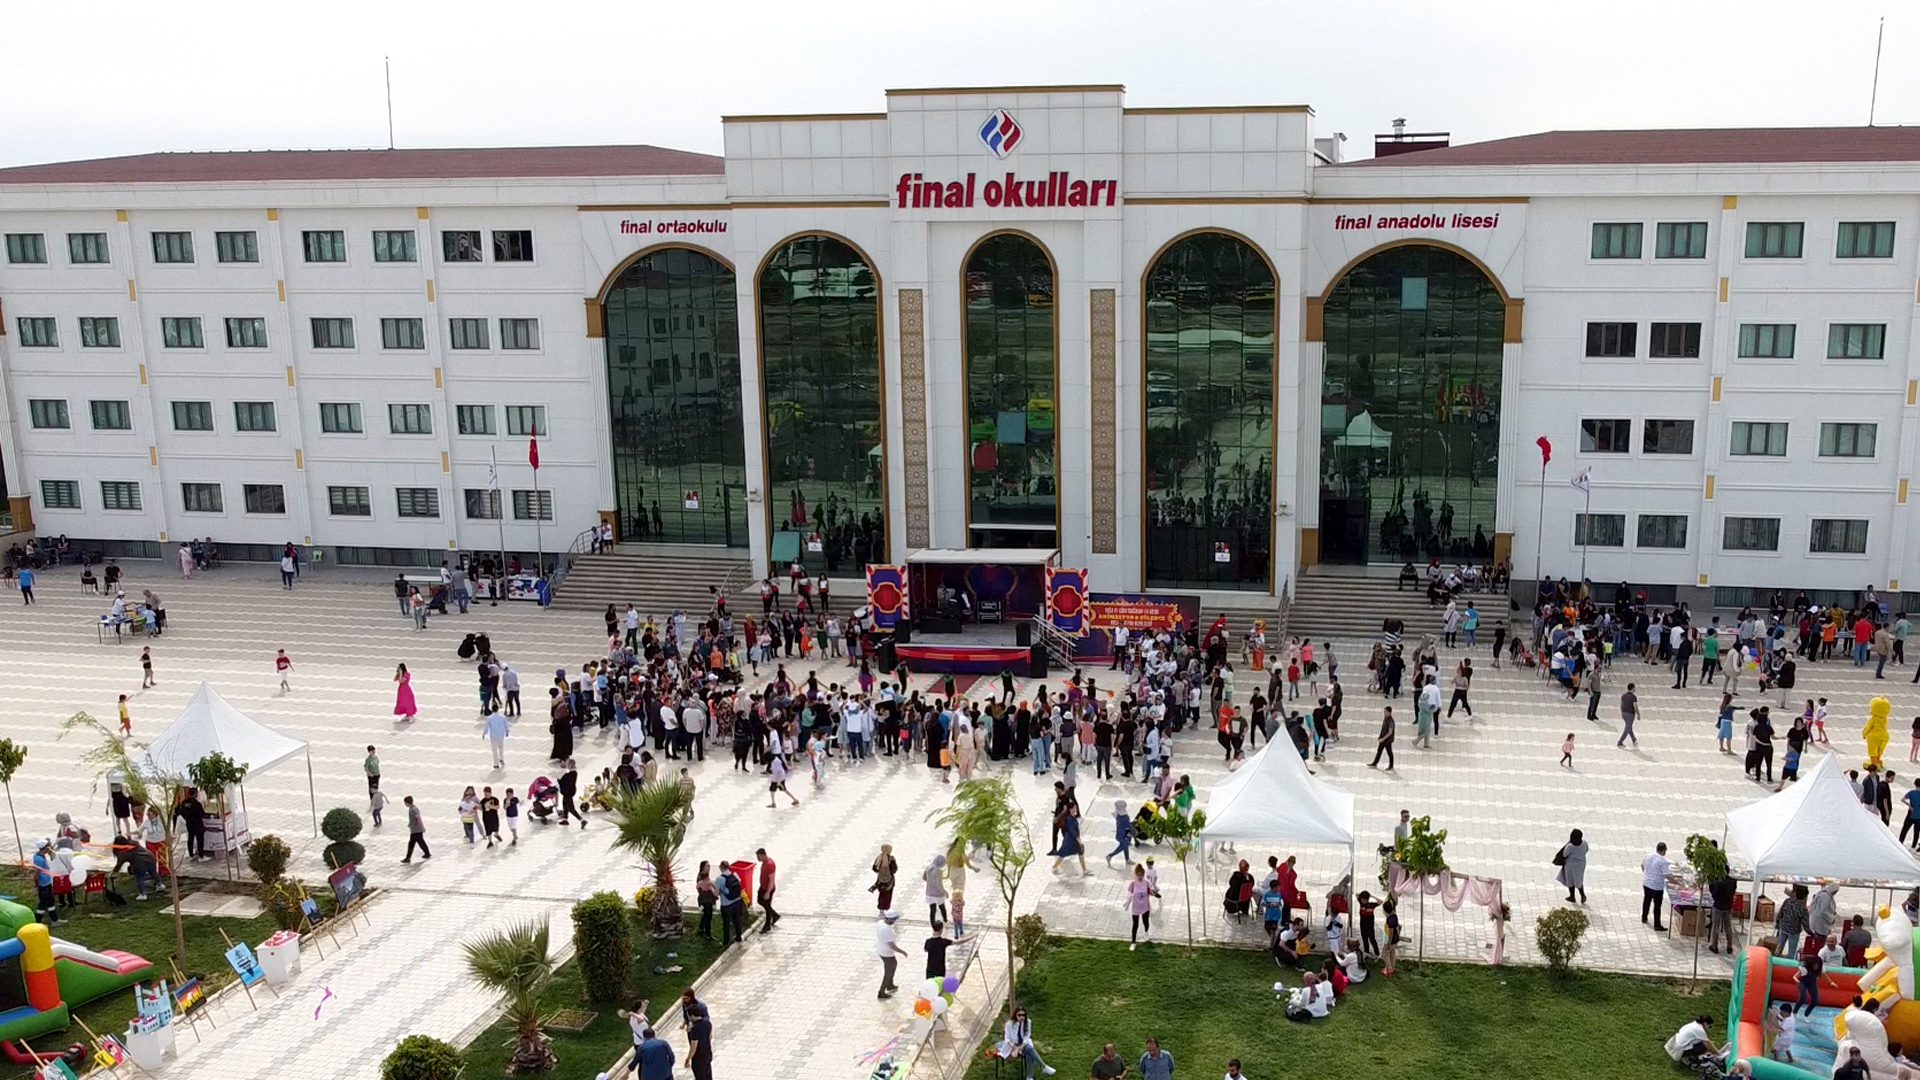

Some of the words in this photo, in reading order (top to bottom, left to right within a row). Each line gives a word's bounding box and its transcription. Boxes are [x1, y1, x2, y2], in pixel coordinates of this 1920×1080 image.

[896, 172, 976, 208] final
[983, 171, 1117, 207] okulları
[620, 220, 652, 234] final
[656, 219, 728, 233] ortaokulu
[1334, 214, 1372, 230] final
[1377, 213, 1446, 229] anadolu
[1451, 213, 1500, 229] lisesi
